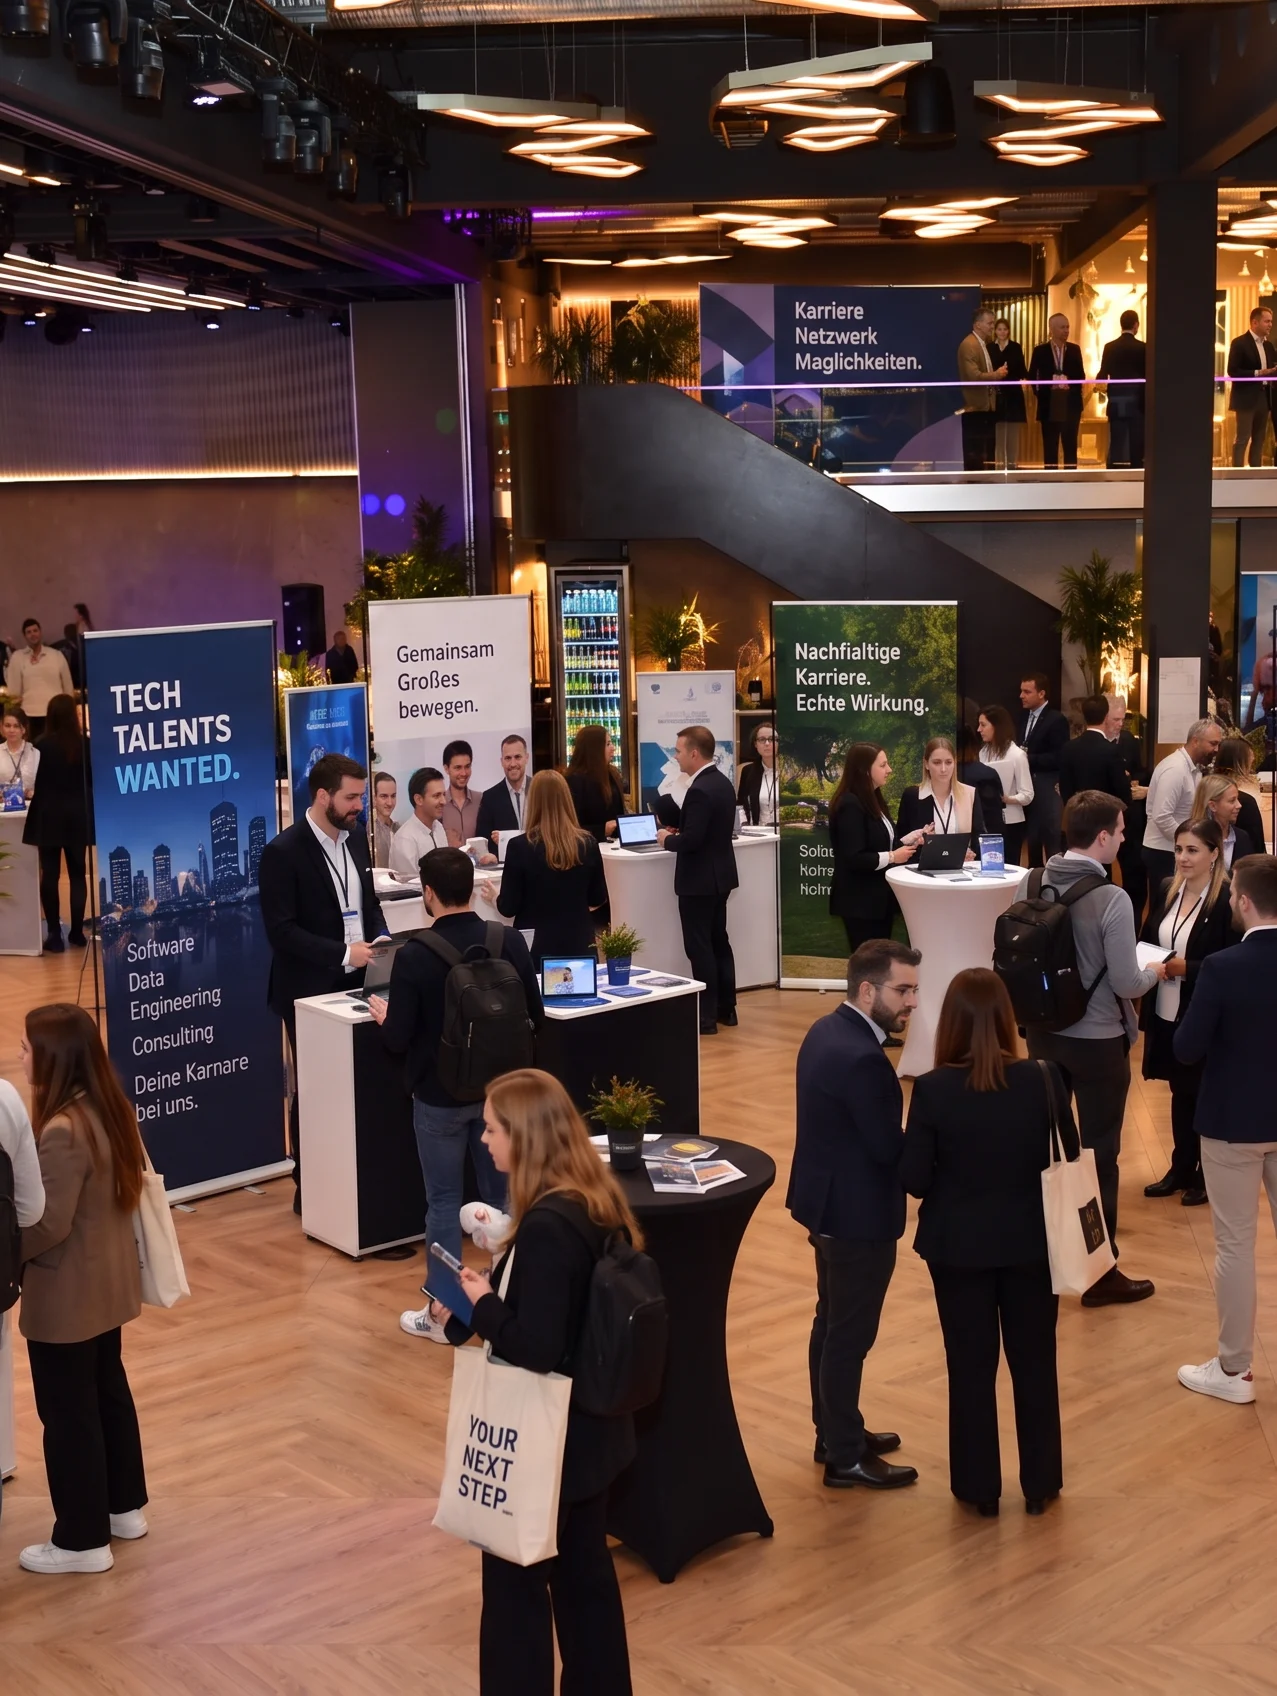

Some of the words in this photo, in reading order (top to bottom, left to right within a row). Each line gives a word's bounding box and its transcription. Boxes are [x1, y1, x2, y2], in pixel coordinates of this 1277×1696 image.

[795, 301, 864, 320] Karriere
[795, 326, 878, 345] Netzwerk
[795, 352, 923, 375] Maglichkeiten.
[396, 642, 494, 663] Gemainsam
[795, 642, 901, 665] Nachfialtige
[397, 670, 460, 691] Großes
[795, 668, 871, 686] Karriere.
[110, 680, 182, 714] TECH
[399, 699, 479, 720] bewegen.
[796, 693, 846, 712] Echte
[850, 693, 930, 716] Wirkung.
[112, 714, 232, 754] TALENTS
[114, 753, 240, 795] WANTED.
[127, 937, 195, 963] Software
[129, 970, 165, 993] Data
[130, 987, 222, 1021] Engineering
[132, 1025, 214, 1057] Consulting
[134, 1071, 181, 1095] Deine
[186, 1056, 249, 1083] Karnare
[135, 1099, 161, 1123] bei
[165, 1095, 199, 1115] uns.
[469, 1413, 518, 1453] YOUR
[462, 1444, 514, 1482] NEXT
[458, 1473, 507, 1510] STEP
